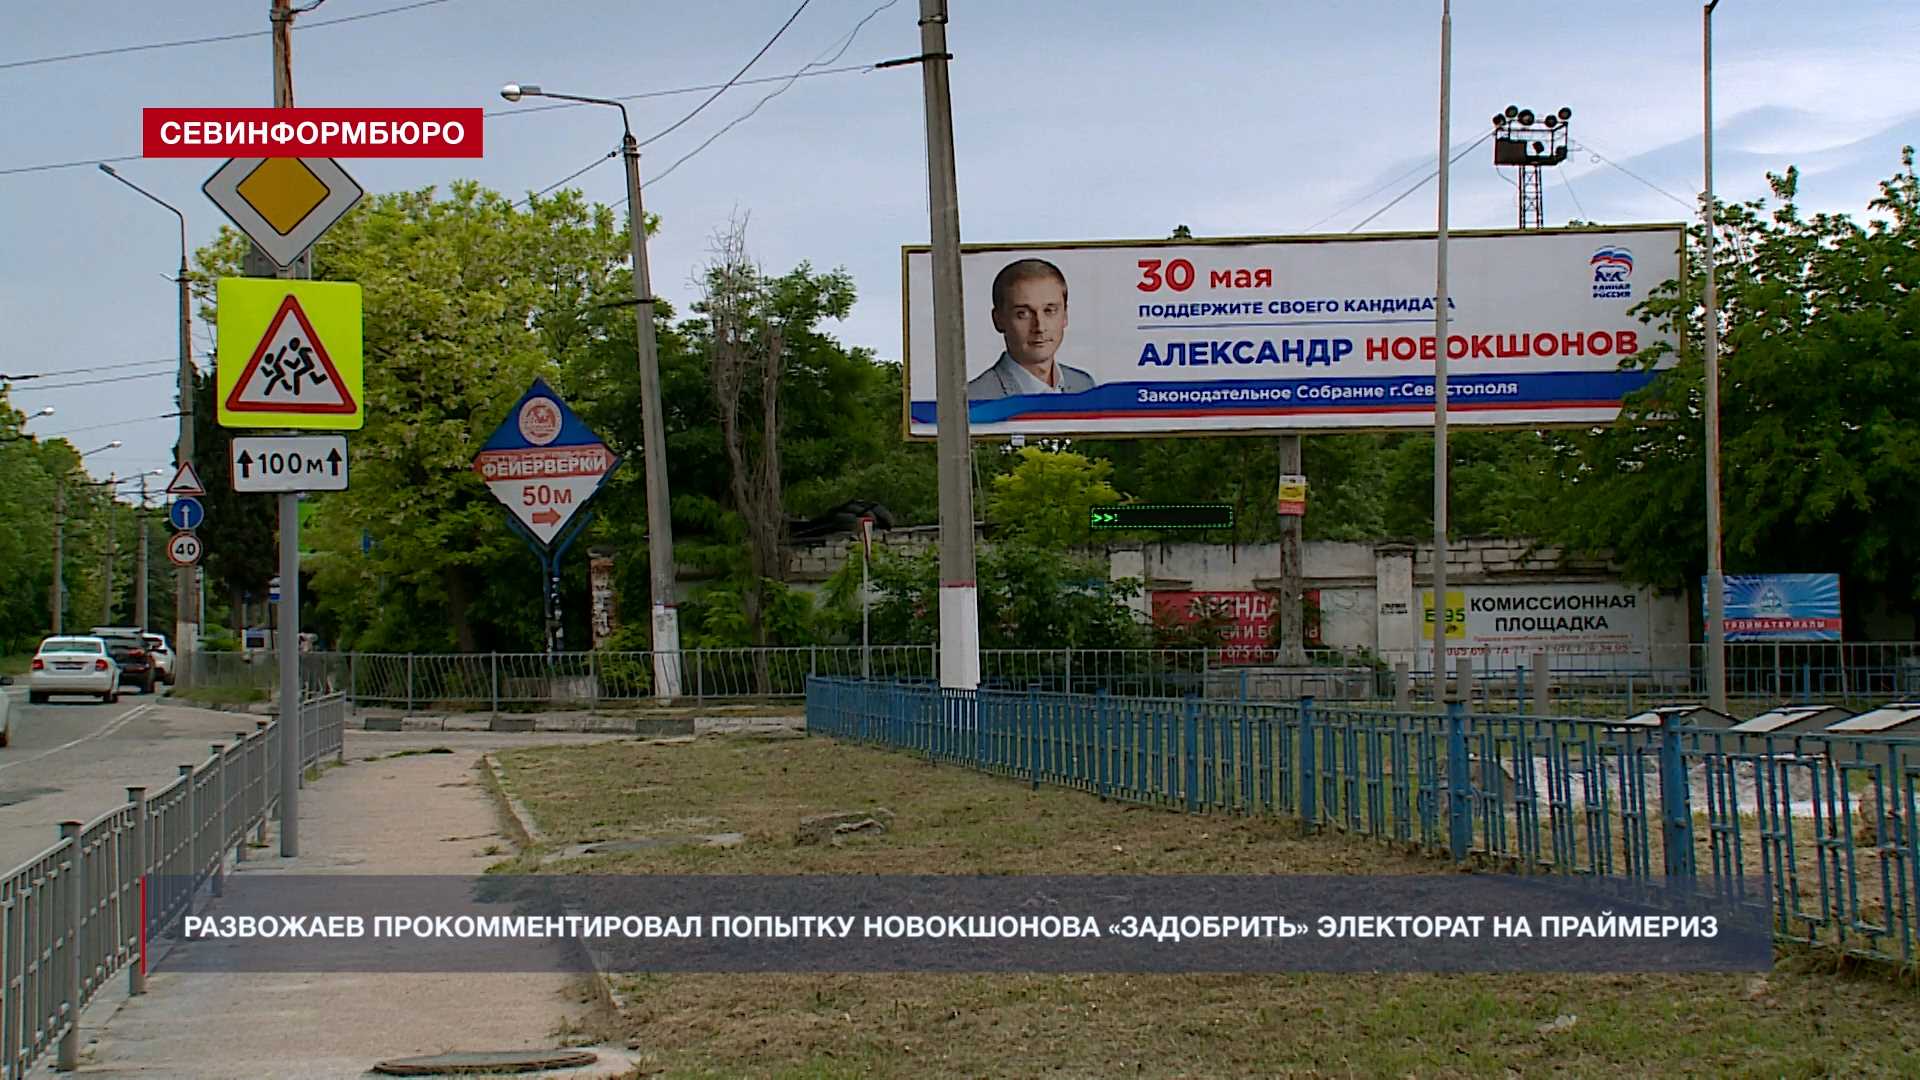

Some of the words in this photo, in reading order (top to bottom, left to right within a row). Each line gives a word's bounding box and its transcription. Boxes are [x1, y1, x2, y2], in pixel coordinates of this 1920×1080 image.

[1136, 258, 1195, 292] 30
[1209, 268, 1272, 289] мая
[1138, 301, 1262, 319] ПОДДЕРЖИТЕ
[1268, 299, 1338, 315] СВОЕГО
[1138, 338, 1353, 367] АЛЕКСАНДР
[1366, 331, 1638, 362] НОВОКШОНОВ
[1138, 387, 1292, 404] Законодательное
[1296, 384, 1384, 402] Собрание
[1389, 382, 1518, 397] г.Севстополя
[175, 543, 196, 556] 40
[1471, 595, 1636, 612] КОМИССИОННАЯ
[1495, 615, 1609, 632] ПЛОЩАДКА
[1724, 620, 1826, 630] ТРОЙМАТЕРИАЛЫ
